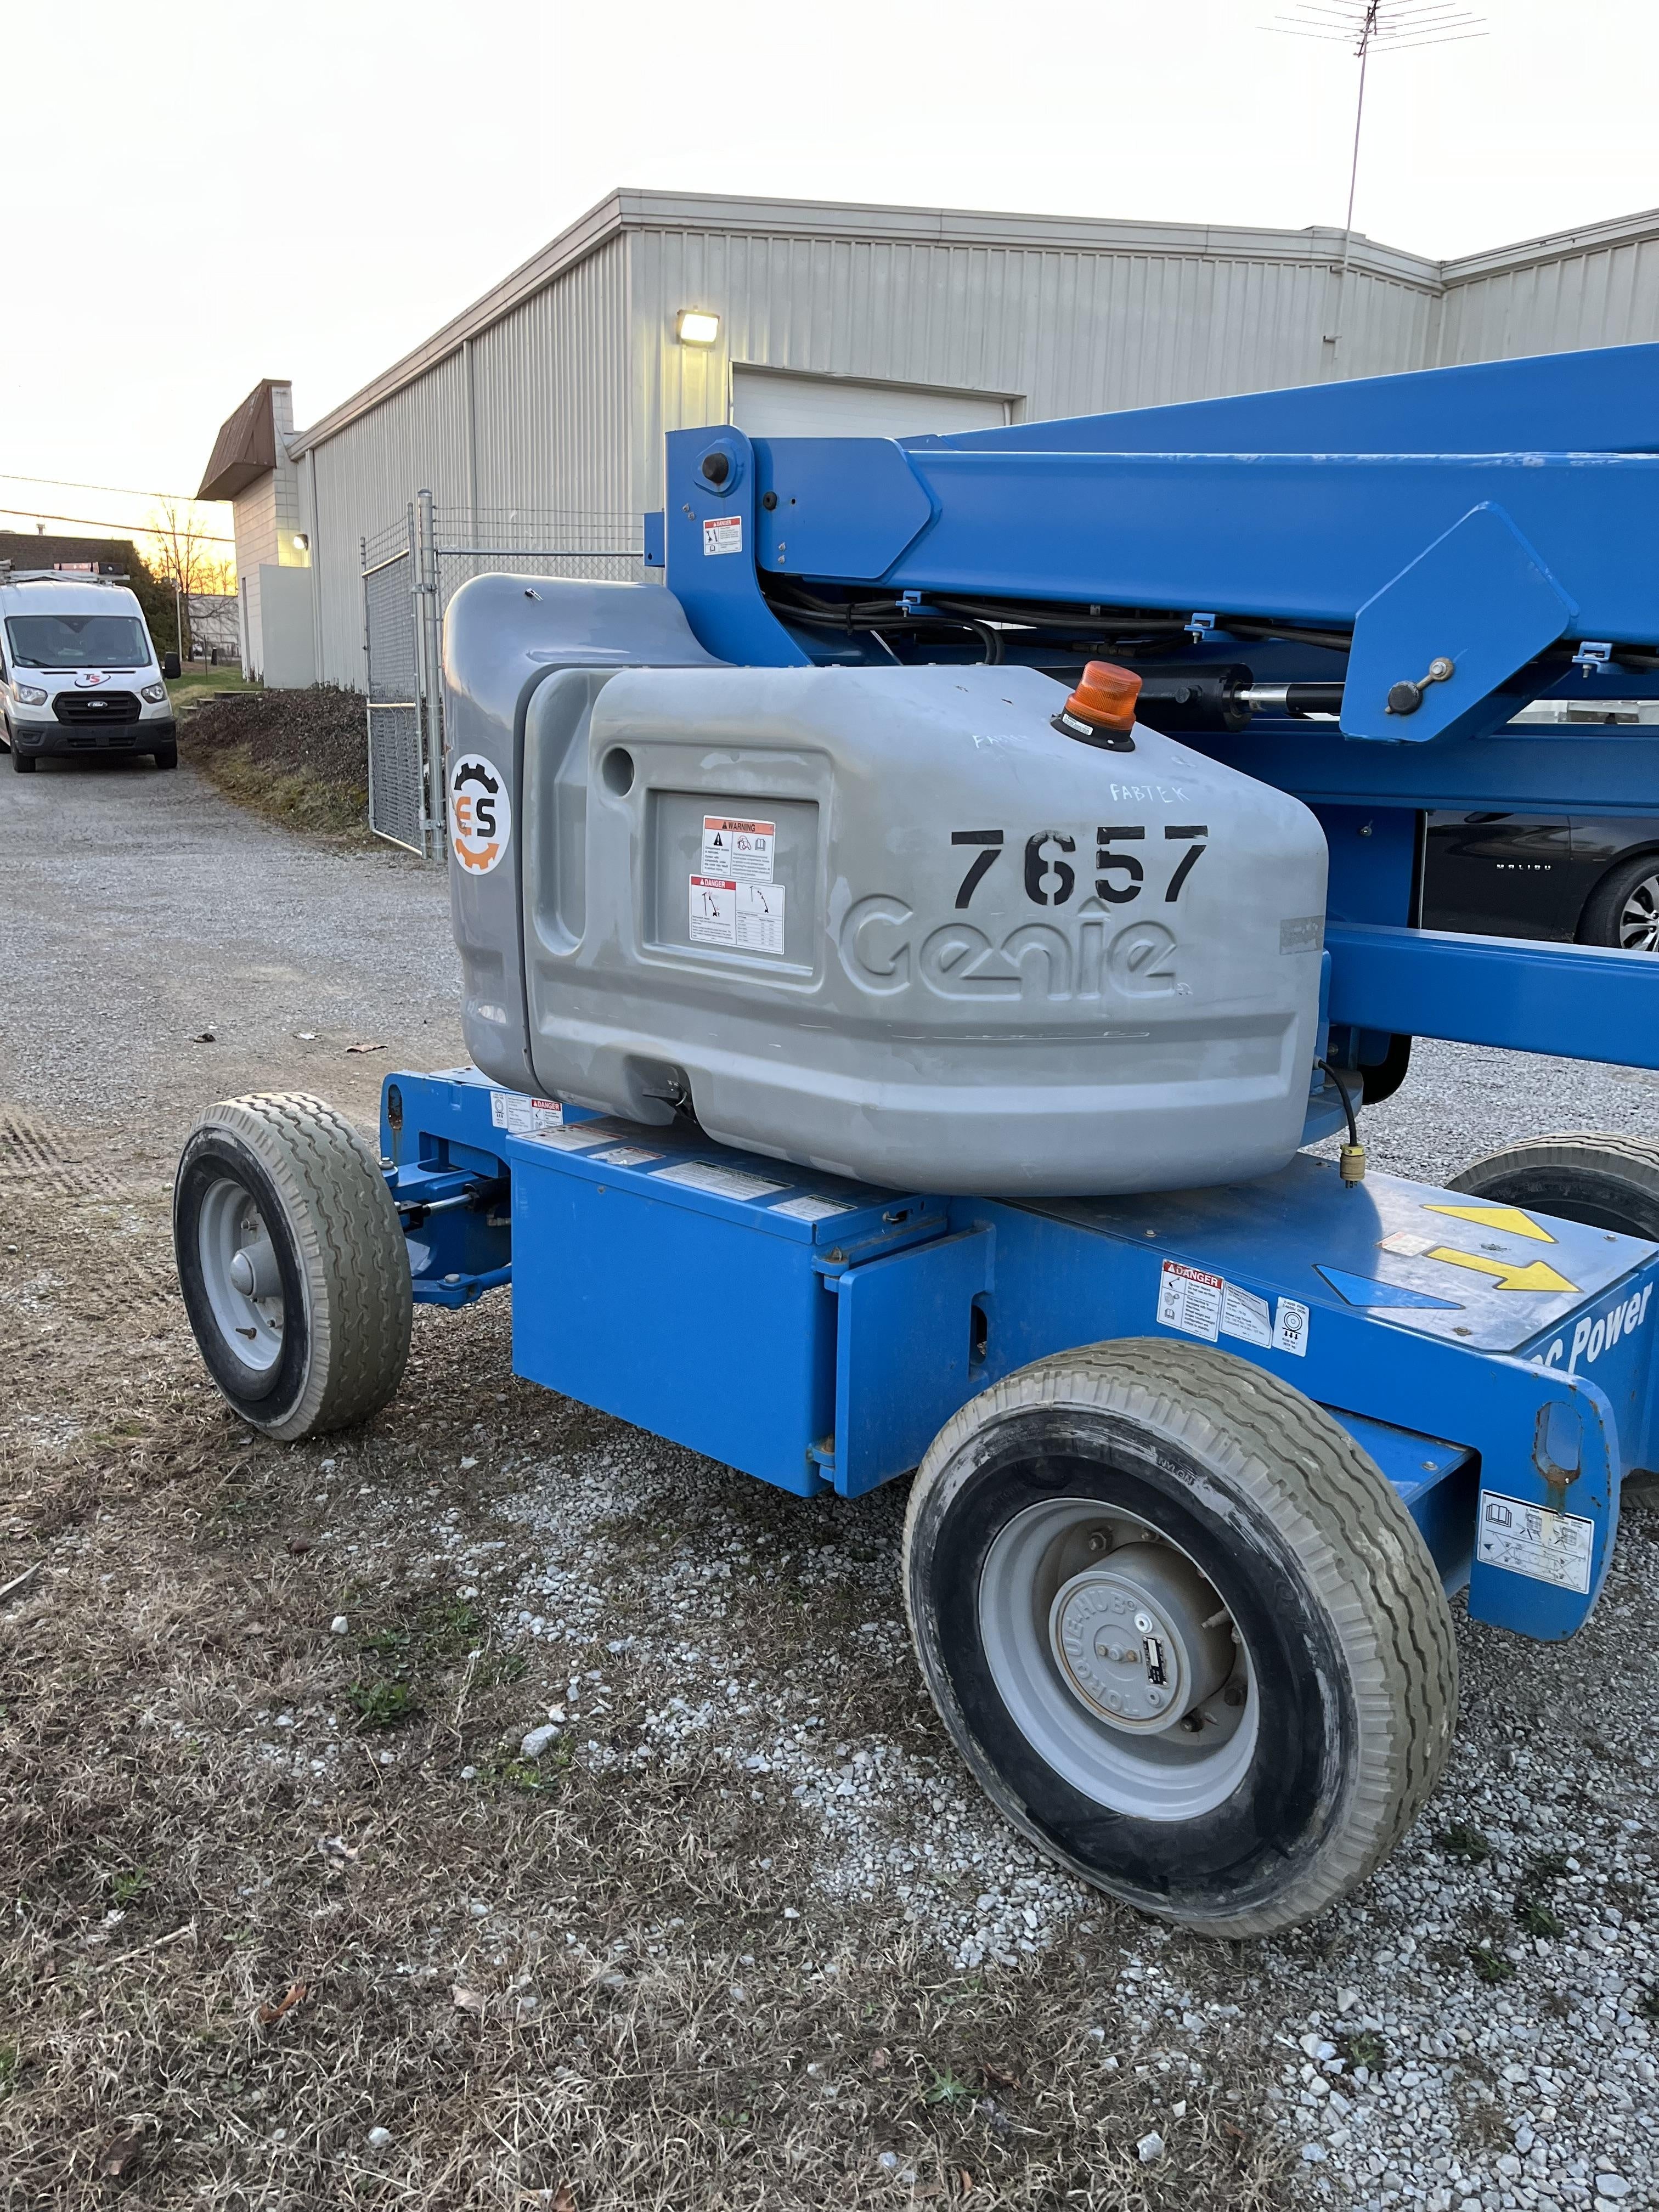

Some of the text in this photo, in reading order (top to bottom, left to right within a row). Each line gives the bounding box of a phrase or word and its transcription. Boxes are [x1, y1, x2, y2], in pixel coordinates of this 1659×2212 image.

[1110, 783, 1190, 803] FABTEK
[728, 822, 755, 832] WARNING
[951, 825, 1209, 909] 7657
[839, 893, 1177, 1001] Genie
[538, 1102, 560, 1110] DANGER
[1176, 1266, 1218, 1286] DANGER
[1568, 1281, 1654, 1375] Power
